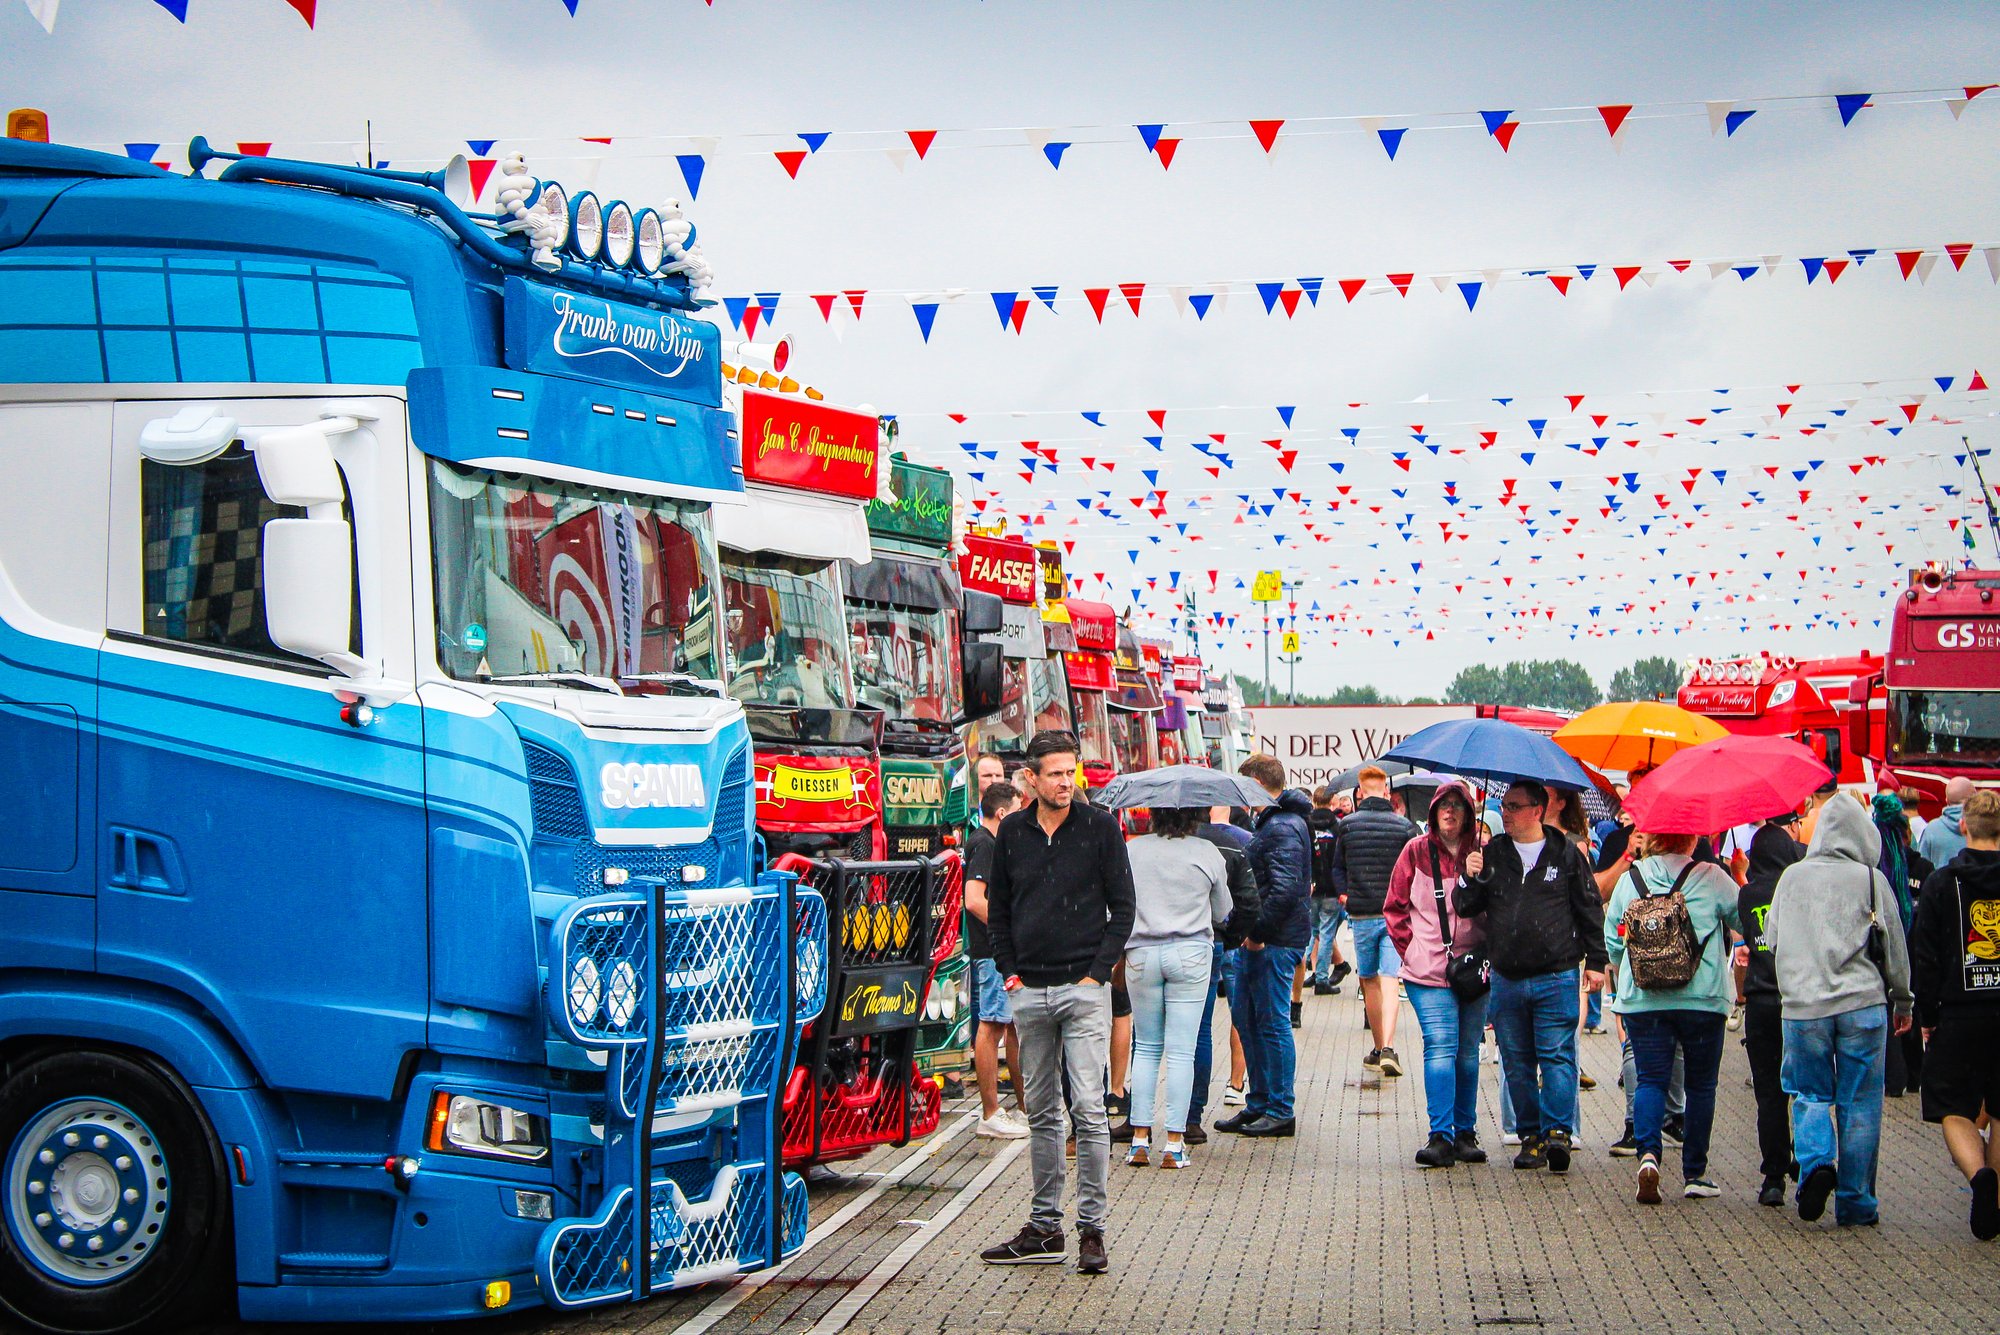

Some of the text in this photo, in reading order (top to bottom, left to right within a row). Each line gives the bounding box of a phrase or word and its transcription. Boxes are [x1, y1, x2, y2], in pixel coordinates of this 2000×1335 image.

[553, 292, 620, 345] Frank
[622, 323, 659, 352] van
[759, 417, 785, 459] Jan
[969, 555, 1033, 588] FAASSE
[1286, 636, 1296, 649] A
[1937, 622, 1975, 648] GS
[1290, 735, 1342, 757] DER
[602, 763, 705, 808] SCANIA
[791, 777, 839, 792] GIESSEN
[887, 776, 943, 804] SCANIA
[897, 838, 928, 853] SUPER
